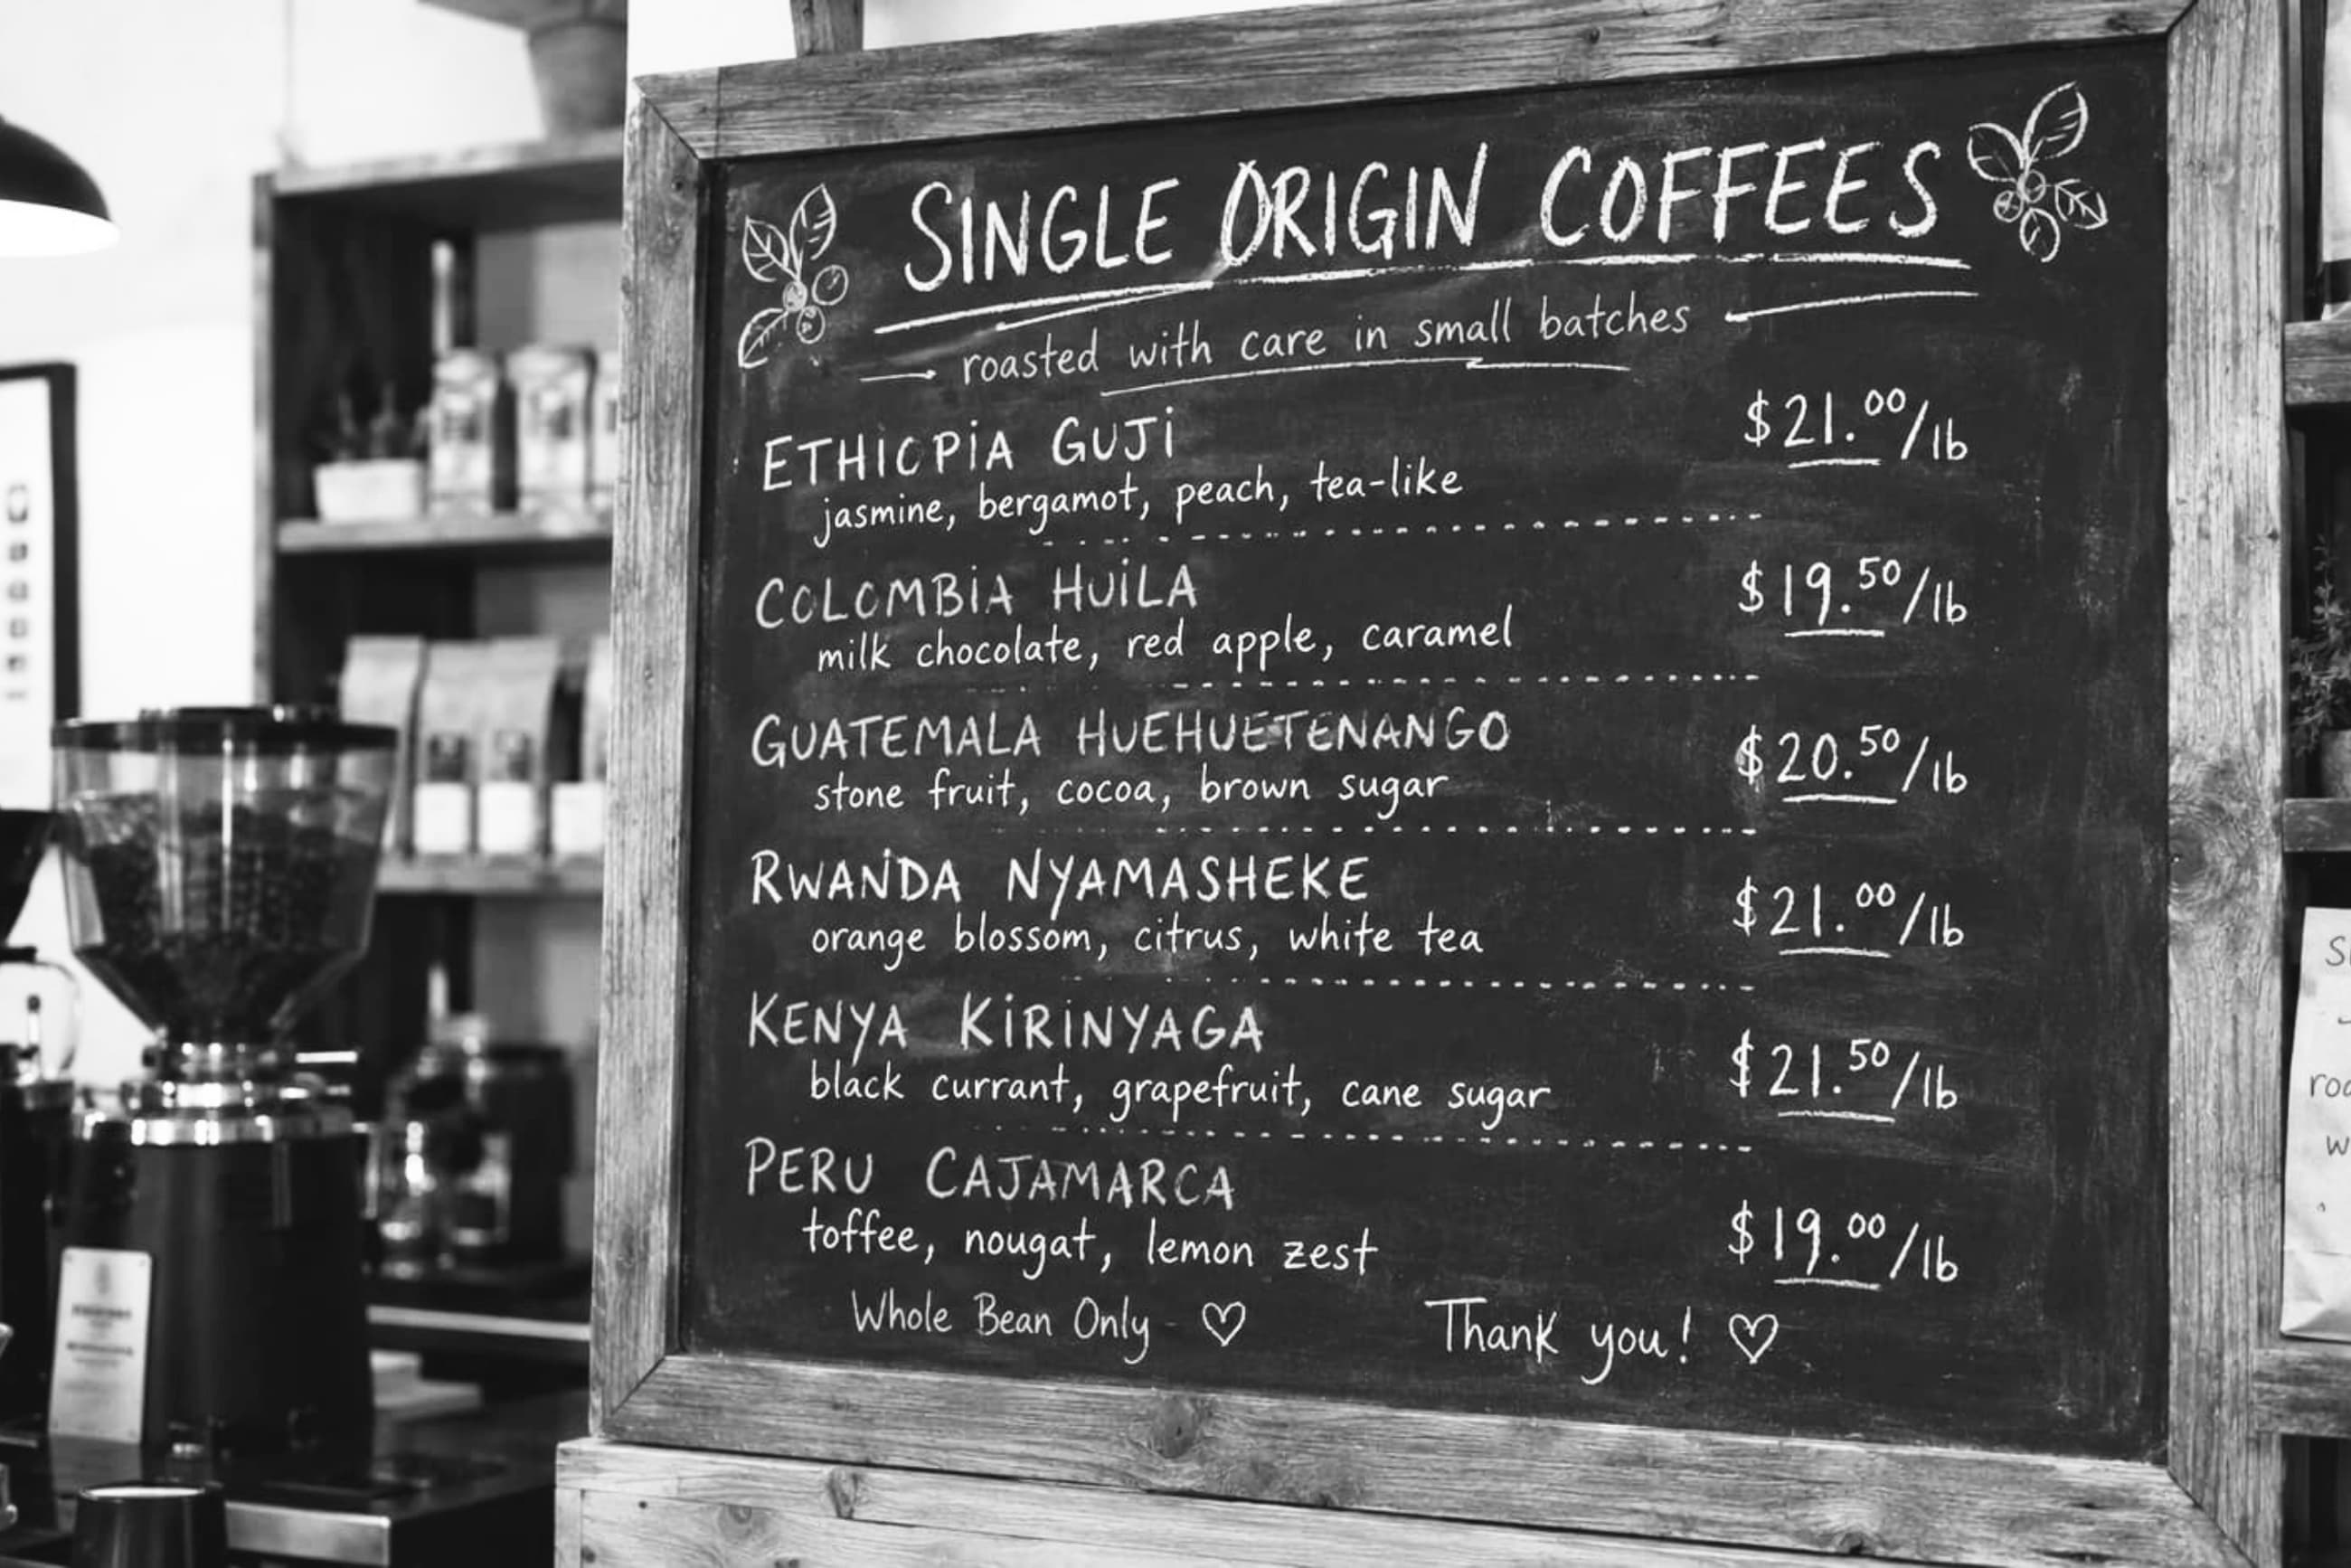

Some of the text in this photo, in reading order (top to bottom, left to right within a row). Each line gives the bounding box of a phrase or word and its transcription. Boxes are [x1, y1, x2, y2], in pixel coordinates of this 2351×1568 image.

[903, 137, 1941, 292] SINGLE ORIGIN COFFEES
[963, 290, 1691, 386] roasted with care in small batches
[813, 455, 1463, 549] jasmine, bergamot, peach, tea-like
[817, 603, 1513, 674] milk chocolate, red apple, caramel
[751, 705, 1510, 770] GUATEMALA HUEHUETENANGO
[814, 761, 1449, 820] stone fruit, cocoa, brown sugar
[751, 847, 1369, 924] RWANDA NYAMASHEKE
[811, 910, 1484, 972] orange blossom, citrus, white tea
[2325, 935, 2351, 967] S
[749, 991, 908, 1067] KENYA
[810, 1058, 1552, 1131] black currant, grapefruit, cane sugar
[745, 1137, 1235, 1211] PERU CAJAMARCA
[802, 1206, 1379, 1280] toffee, nougat, lemon zest
[852, 1288, 1149, 1365] Whole Bean Only
[1424, 1296, 1691, 1386] Thank you!
